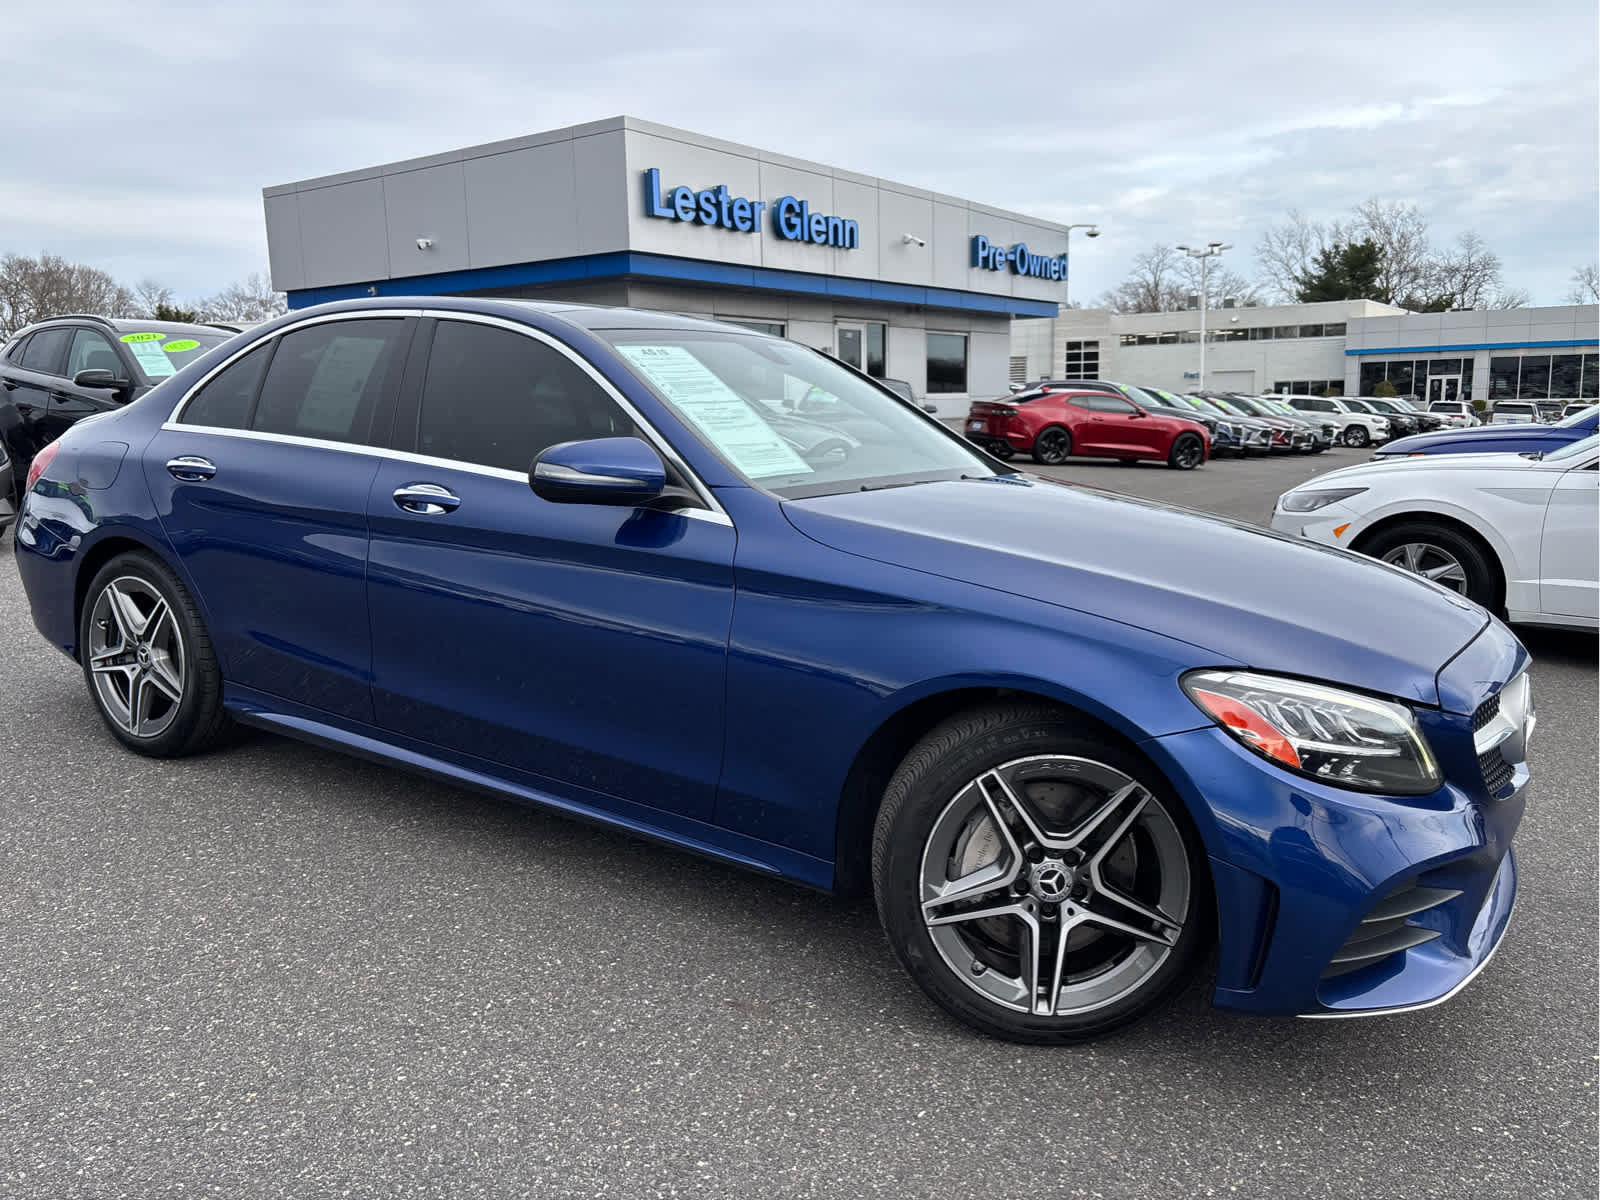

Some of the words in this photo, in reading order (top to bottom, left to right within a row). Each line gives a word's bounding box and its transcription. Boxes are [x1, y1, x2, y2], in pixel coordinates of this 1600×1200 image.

[644, 167, 766, 233] Lester
[772, 195, 859, 249] Glenn
[970, 234, 1069, 281] Pre-Owned
